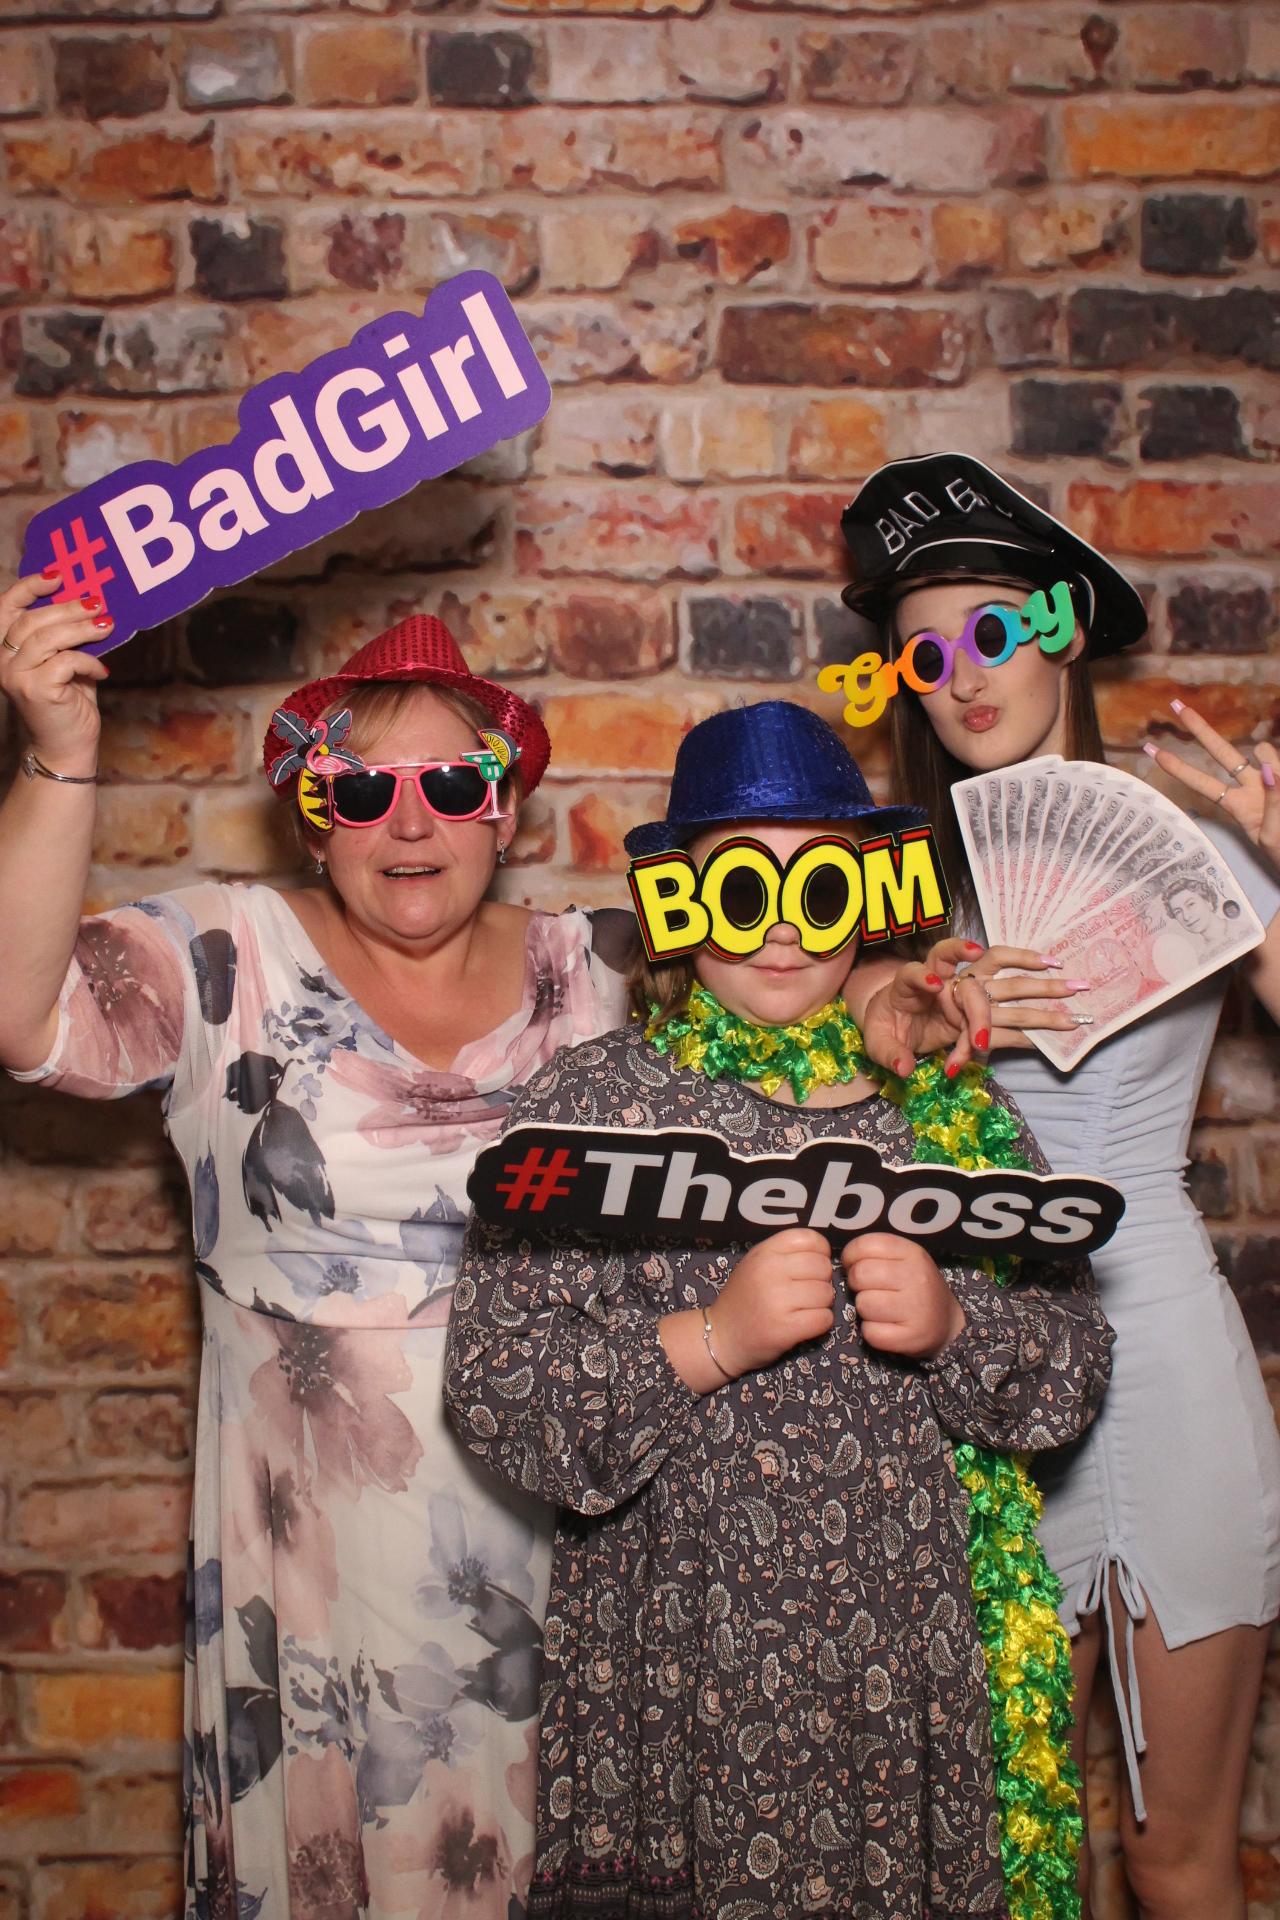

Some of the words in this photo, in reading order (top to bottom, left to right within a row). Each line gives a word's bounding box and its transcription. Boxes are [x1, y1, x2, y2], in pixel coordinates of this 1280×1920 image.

[43, 290, 529, 614] #BadGirl
[874, 491, 941, 555] BAD
[627, 826, 951, 961] BOOM
[496, 1147, 1102, 1244] #Theboss
